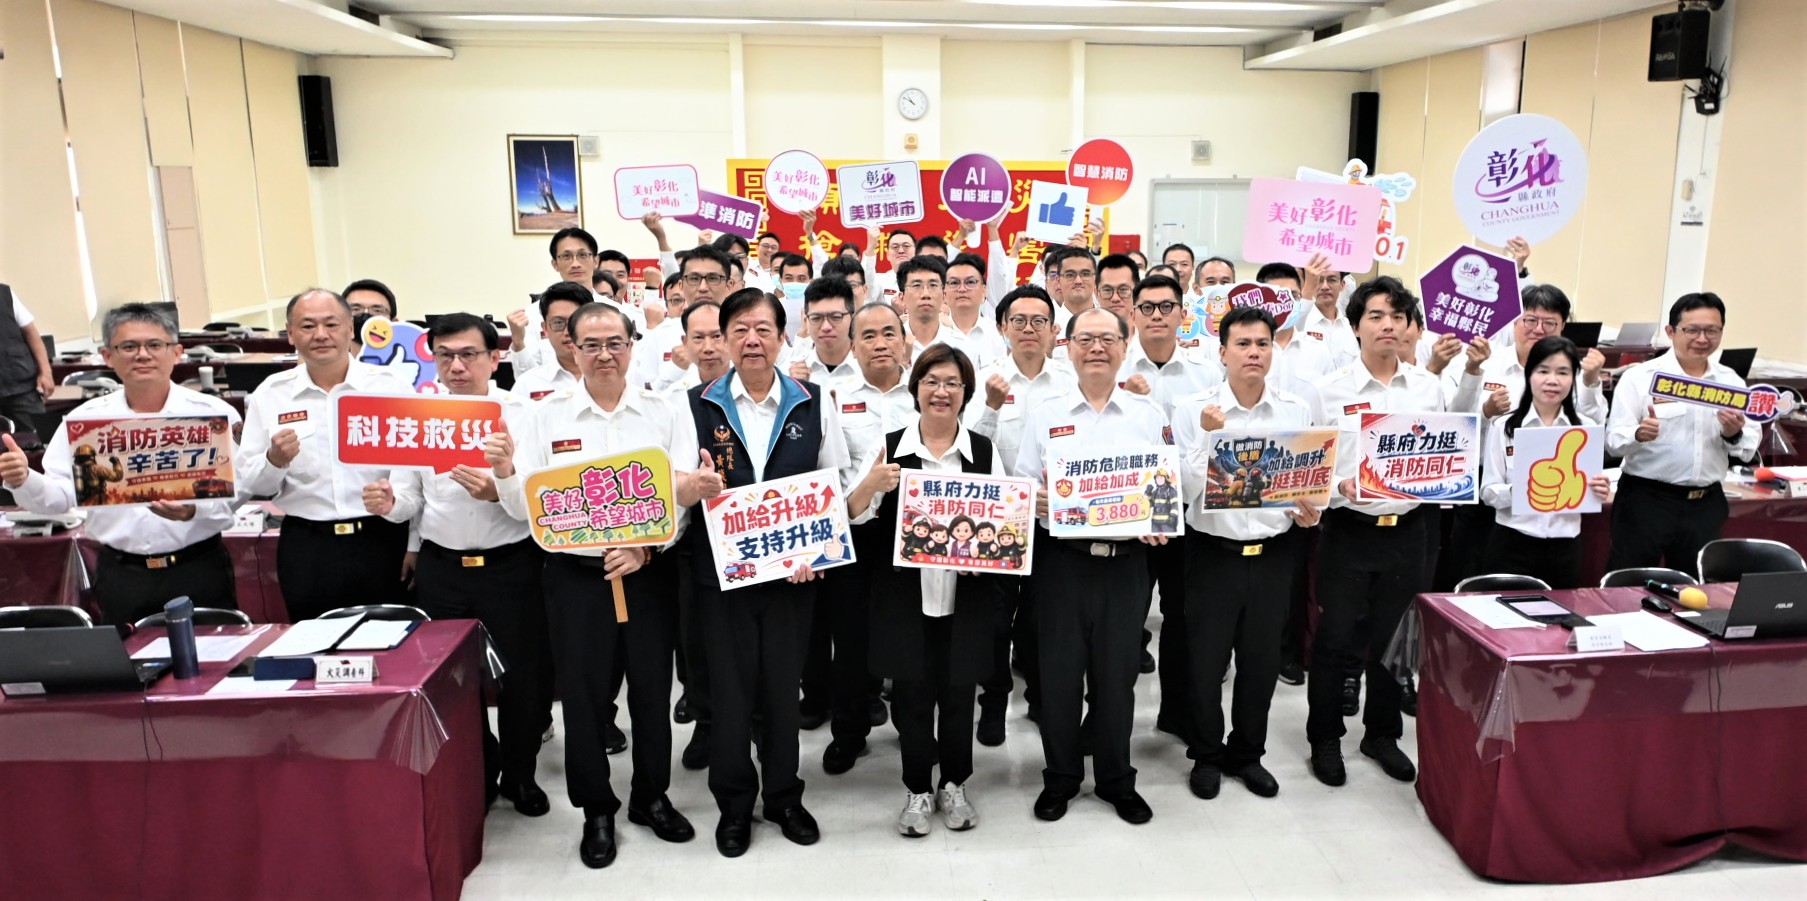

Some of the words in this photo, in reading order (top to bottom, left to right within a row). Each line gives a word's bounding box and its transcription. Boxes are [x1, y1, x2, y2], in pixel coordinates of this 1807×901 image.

[773, 169, 820, 186] 美好彰化
[965, 167, 986, 185] AI
[1073, 163, 1128, 181] 智慧消防
[1487, 147, 1559, 189] 彰化
[633, 179, 679, 196] 美好彰化
[779, 185, 818, 201] 希望城市
[950, 188, 1004, 203] 智能派遣
[642, 196, 680, 208] 希望城市
[850, 200, 915, 221] 美好城市
[1267, 198, 1358, 226] 美好彰化
[1481, 200, 1559, 220] CHANGHUA
[1278, 228, 1354, 256] 希望城市
[1434, 291, 1495, 323] 美好彰化
[1429, 306, 1489, 337] 幸福縣民
[1656, 378, 1747, 408] 彰化縣消防局
[1747, 391, 1778, 416] 讚
[98, 425, 211, 454] 消防英雄
[347, 415, 492, 450] 科技救災
[1377, 431, 1457, 453] 縣府力挺
[127, 448, 217, 473] 辛苦了!
[1065, 453, 1159, 477] 消防危險職務
[1267, 449, 1326, 472] 加給調升
[1384, 455, 1466, 478] 消防同仁
[543, 462, 655, 514] 美好彰化
[1078, 472, 1140, 493] 加給加成
[1271, 466, 1332, 490] 挺到底
[923, 480, 1001, 501] 縣府力挺
[539, 512, 587, 525] CHANGHUA
[590, 500, 665, 529] 希望城市
[722, 493, 819, 536] 加給升級
[928, 499, 1005, 519] 消防同仁
[1096, 503, 1138, 521] 3,880
[553, 520, 587, 530] COUNTY
[736, 517, 833, 561] 支持升級
